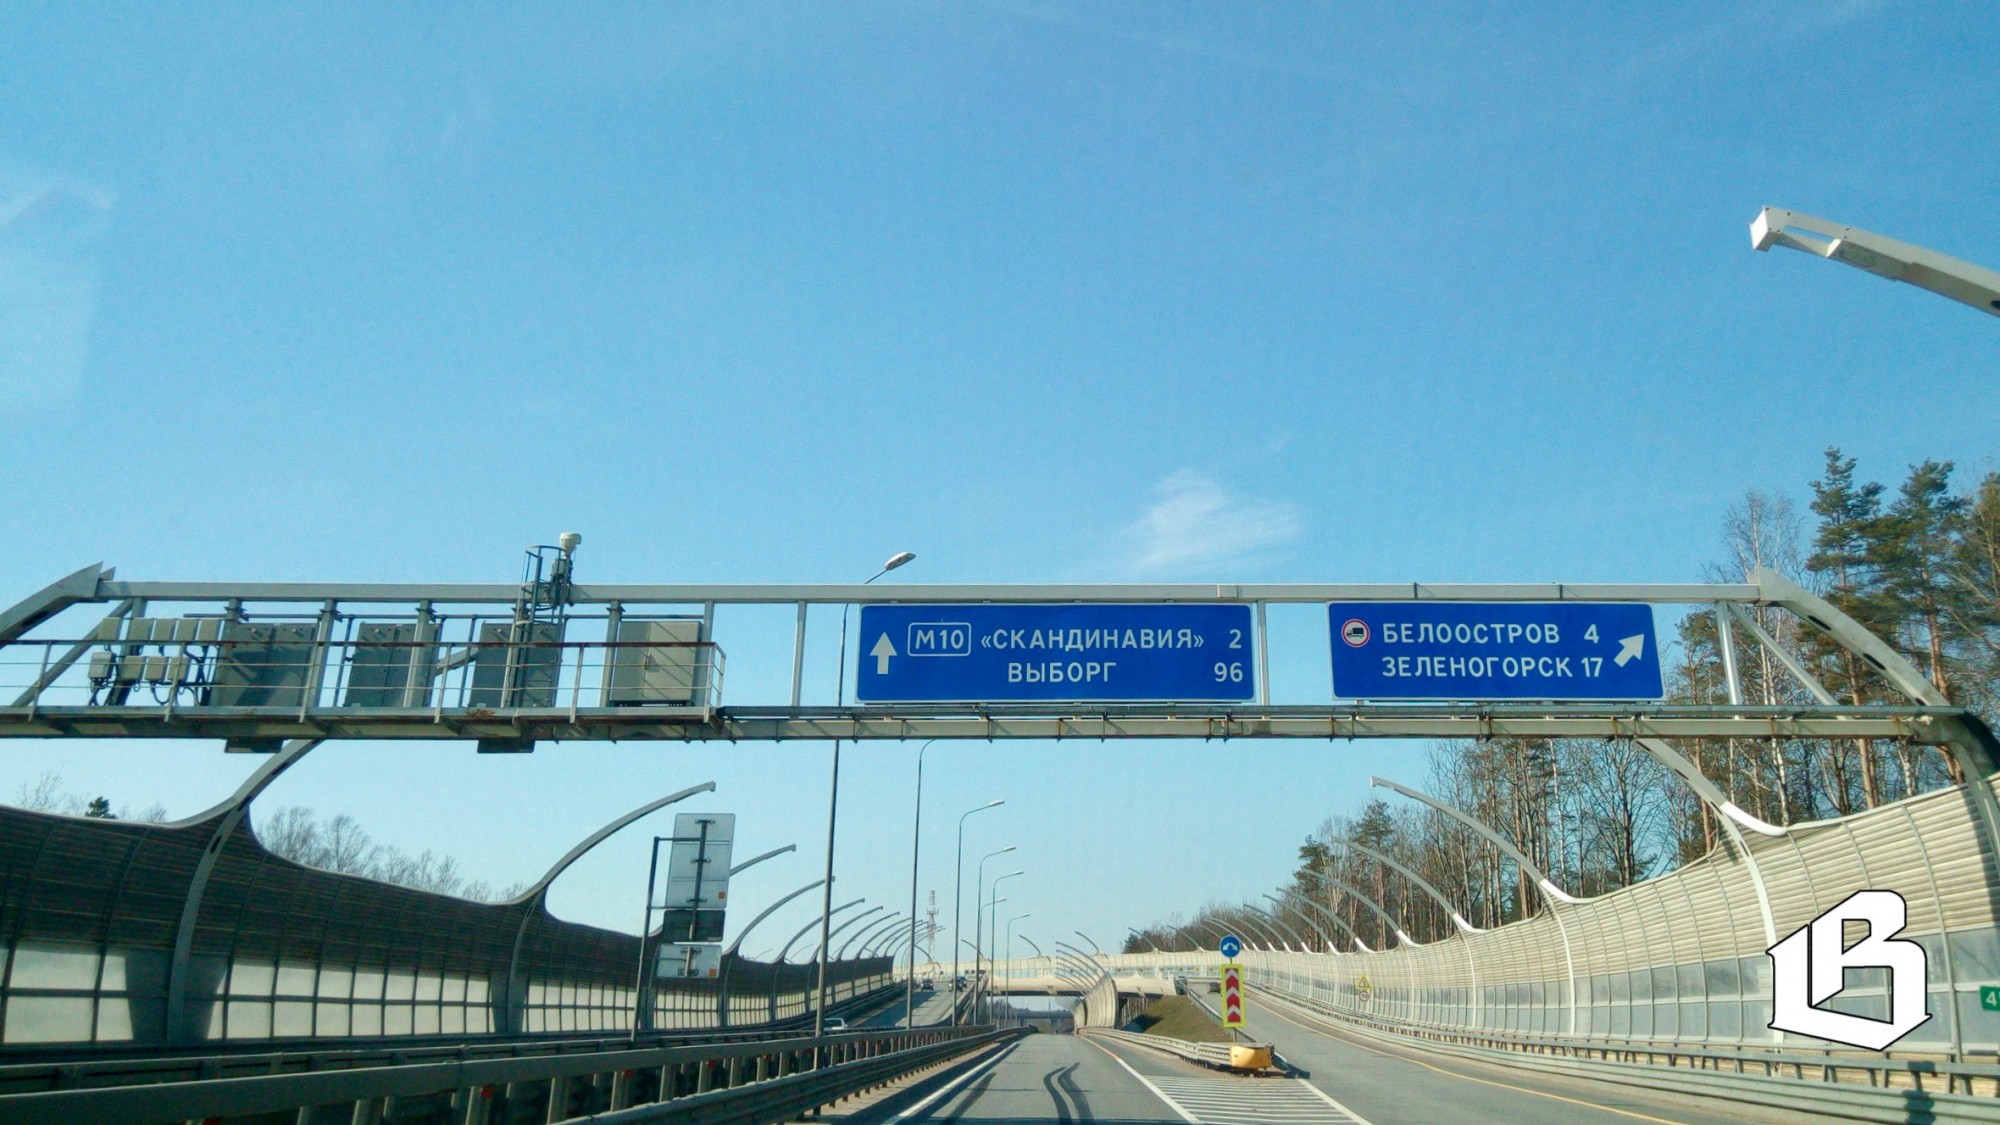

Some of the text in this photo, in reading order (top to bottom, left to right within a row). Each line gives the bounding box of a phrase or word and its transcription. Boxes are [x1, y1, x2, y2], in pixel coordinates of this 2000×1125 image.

[980, 628, 1204, 652] «СКАНДИНАВИЯ»
[1228, 629, 1243, 649] 2
[1382, 623, 1600, 645] БЕЛООСТРОВ 4
[1008, 661, 1244, 683] ВЫБОРГ 96
[1382, 656, 1604, 678] ЗЕЛЕНОГОРСК 17
